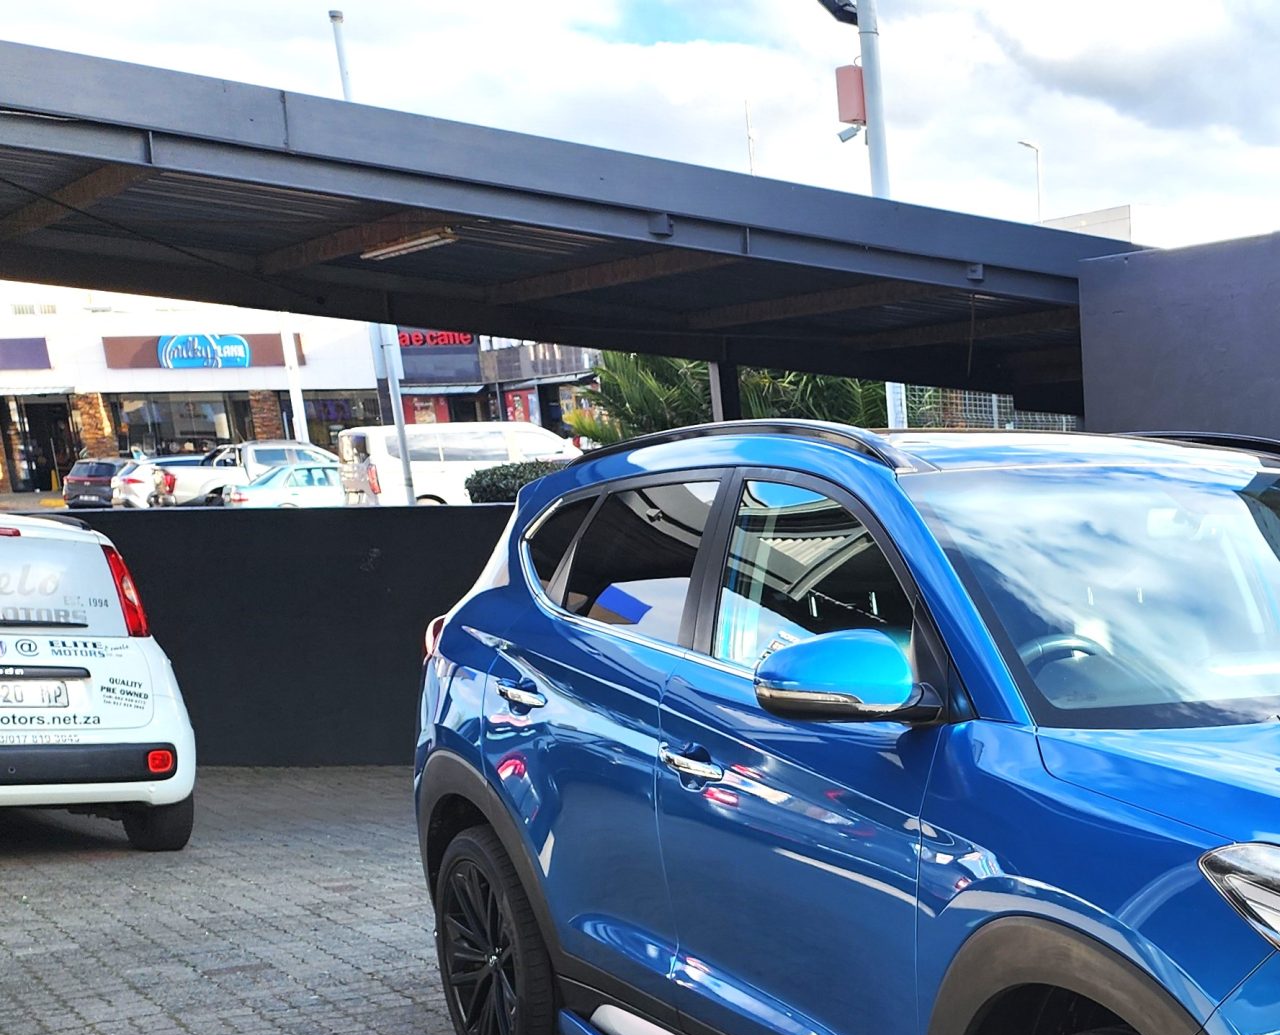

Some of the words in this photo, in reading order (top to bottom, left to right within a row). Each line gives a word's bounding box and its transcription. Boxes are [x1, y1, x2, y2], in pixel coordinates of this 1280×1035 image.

[88, 597, 109, 608] 1994
[48, 640, 104, 650] ELITE
[51, 648, 105, 658] MOTORS
[109, 677, 143, 689] QUALITY
[100, 685, 117, 694] PRE
[119, 689, 149, 700] OWNED
